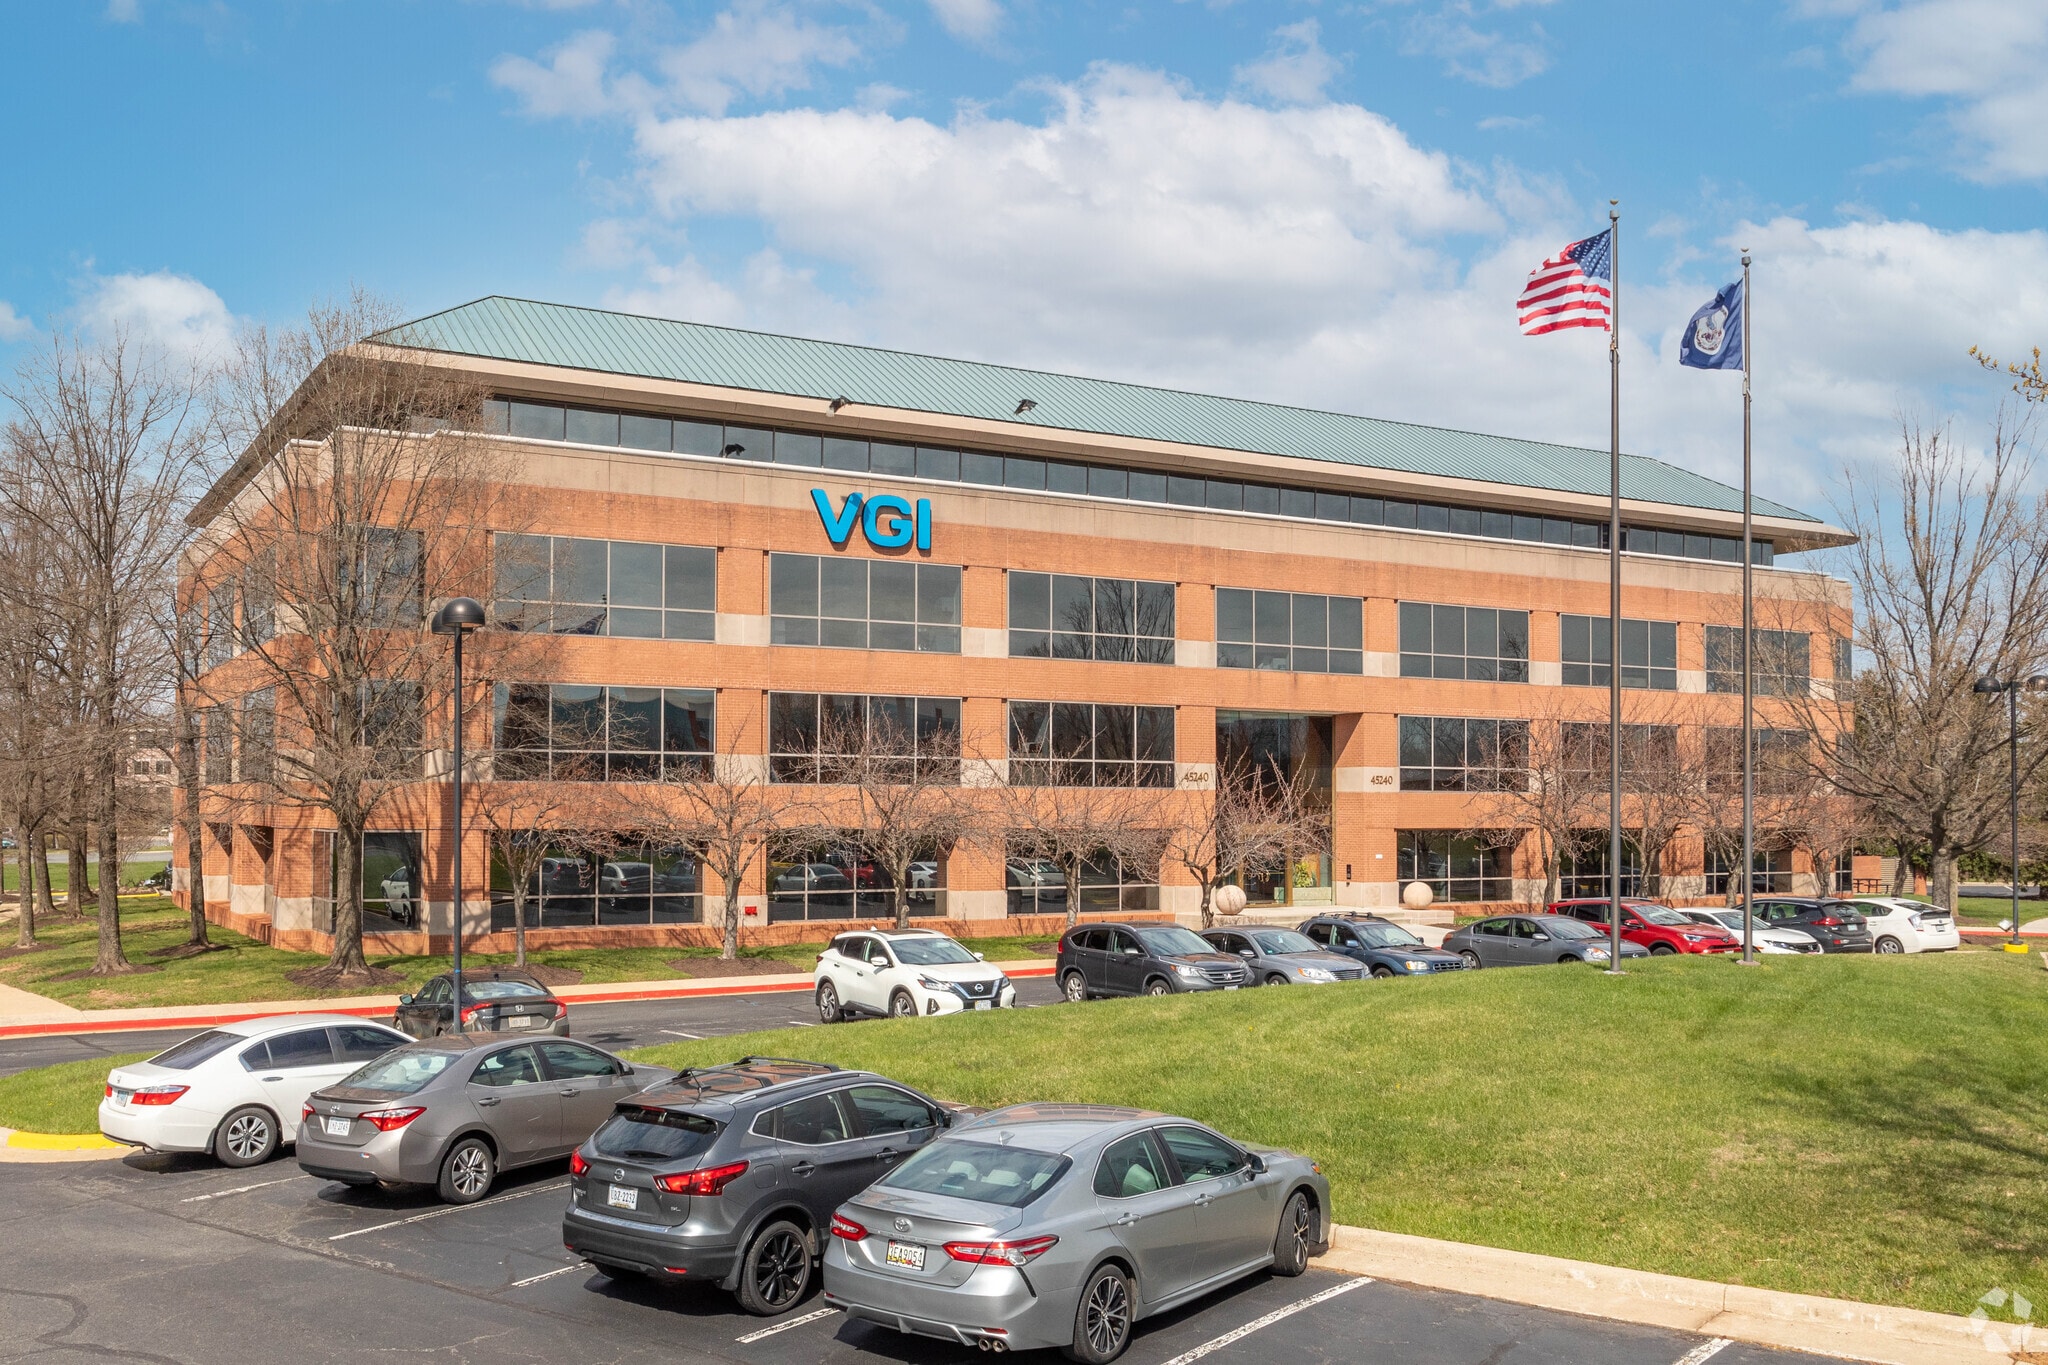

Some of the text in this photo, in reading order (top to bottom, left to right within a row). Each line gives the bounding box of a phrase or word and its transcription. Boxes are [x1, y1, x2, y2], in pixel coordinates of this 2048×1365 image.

[810, 488, 932, 550] VGI
[1184, 772, 1209, 782] 45240
[1371, 775, 1394, 785] 45240
